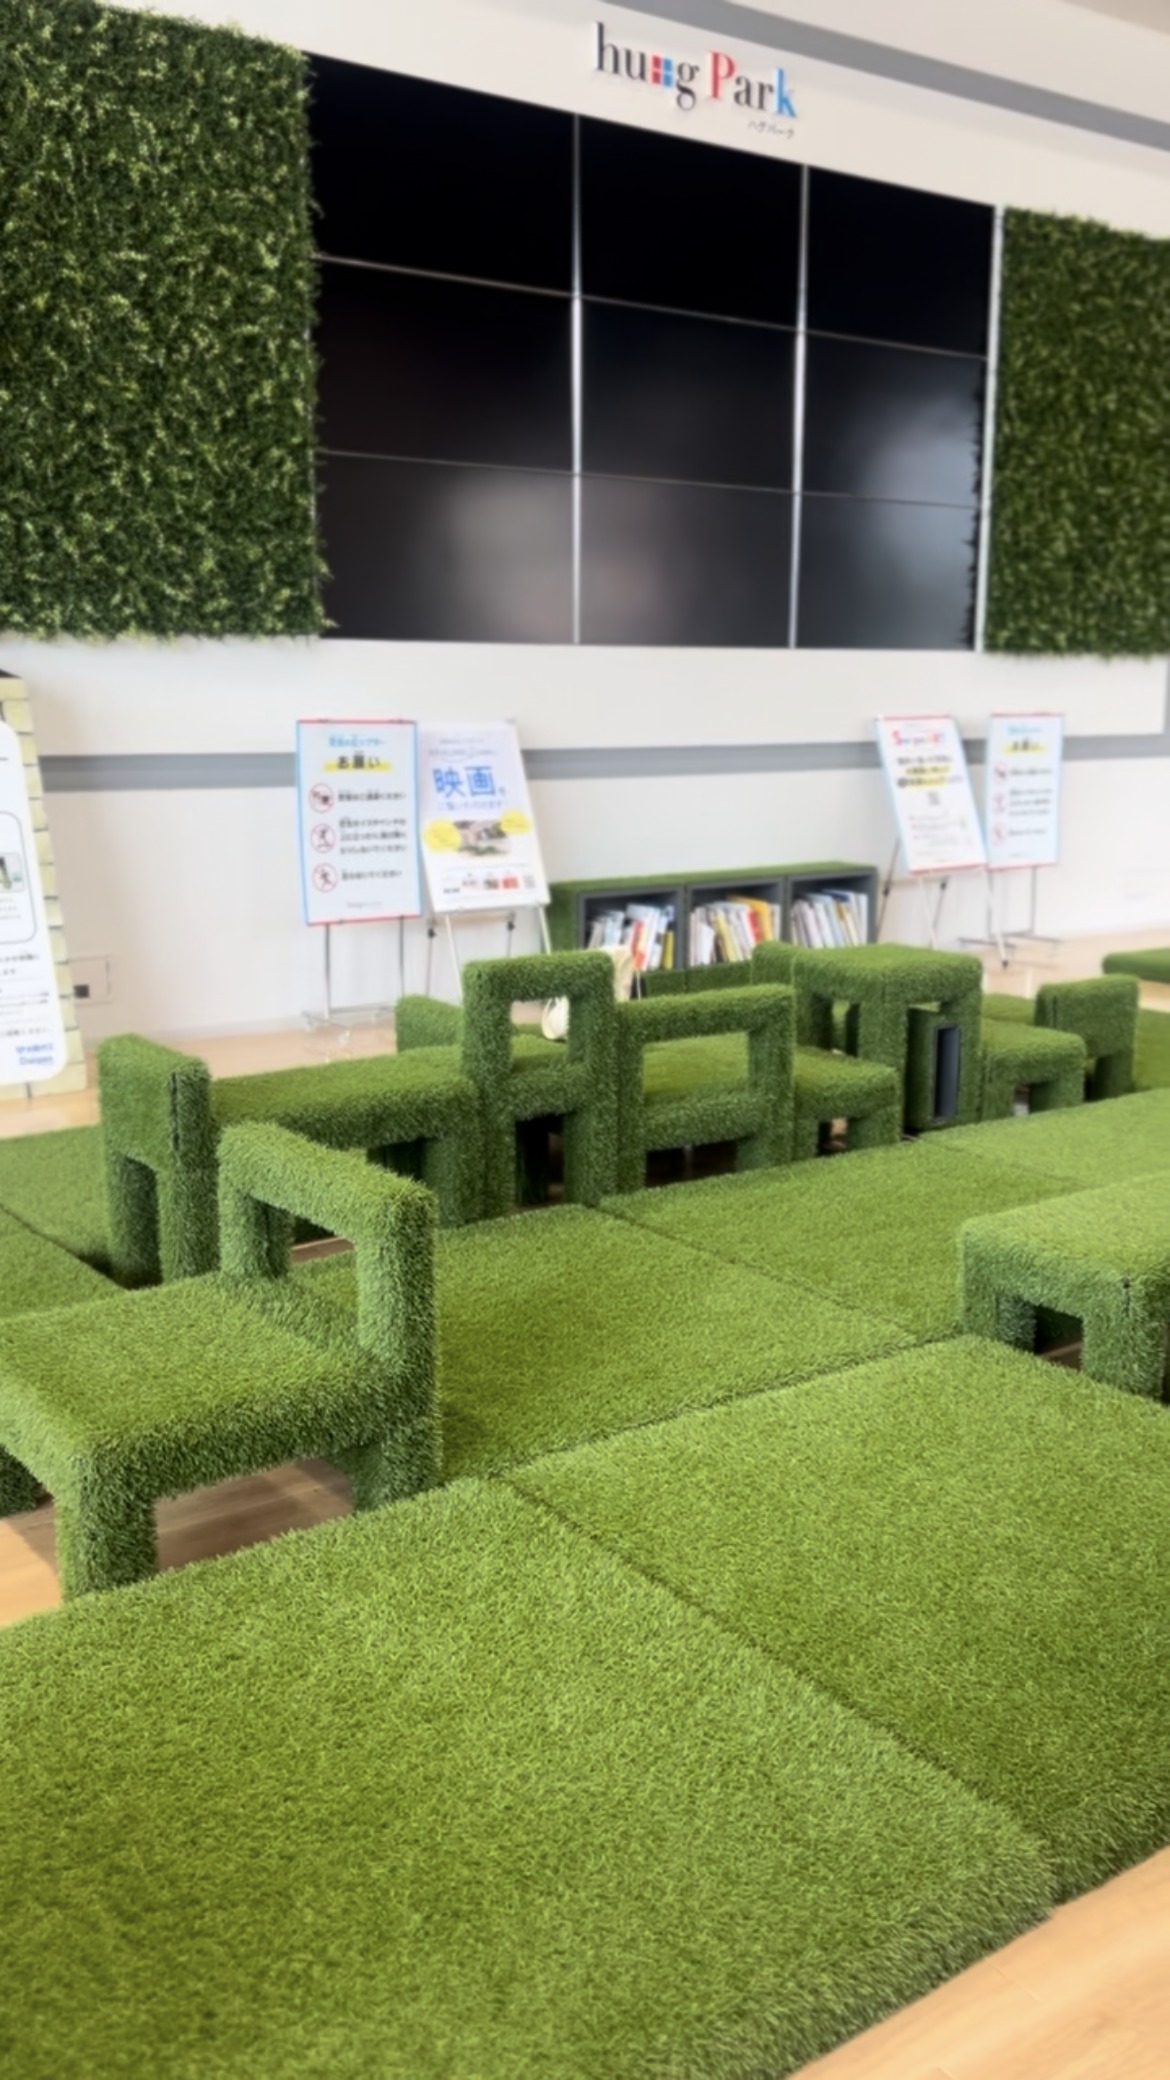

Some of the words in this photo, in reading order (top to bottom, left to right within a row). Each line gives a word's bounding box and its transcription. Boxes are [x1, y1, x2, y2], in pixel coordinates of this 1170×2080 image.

[709, 50, 797, 118] Park
[747, 121, 795, 140] ハグパーク
[337, 752, 381, 770] お願い
